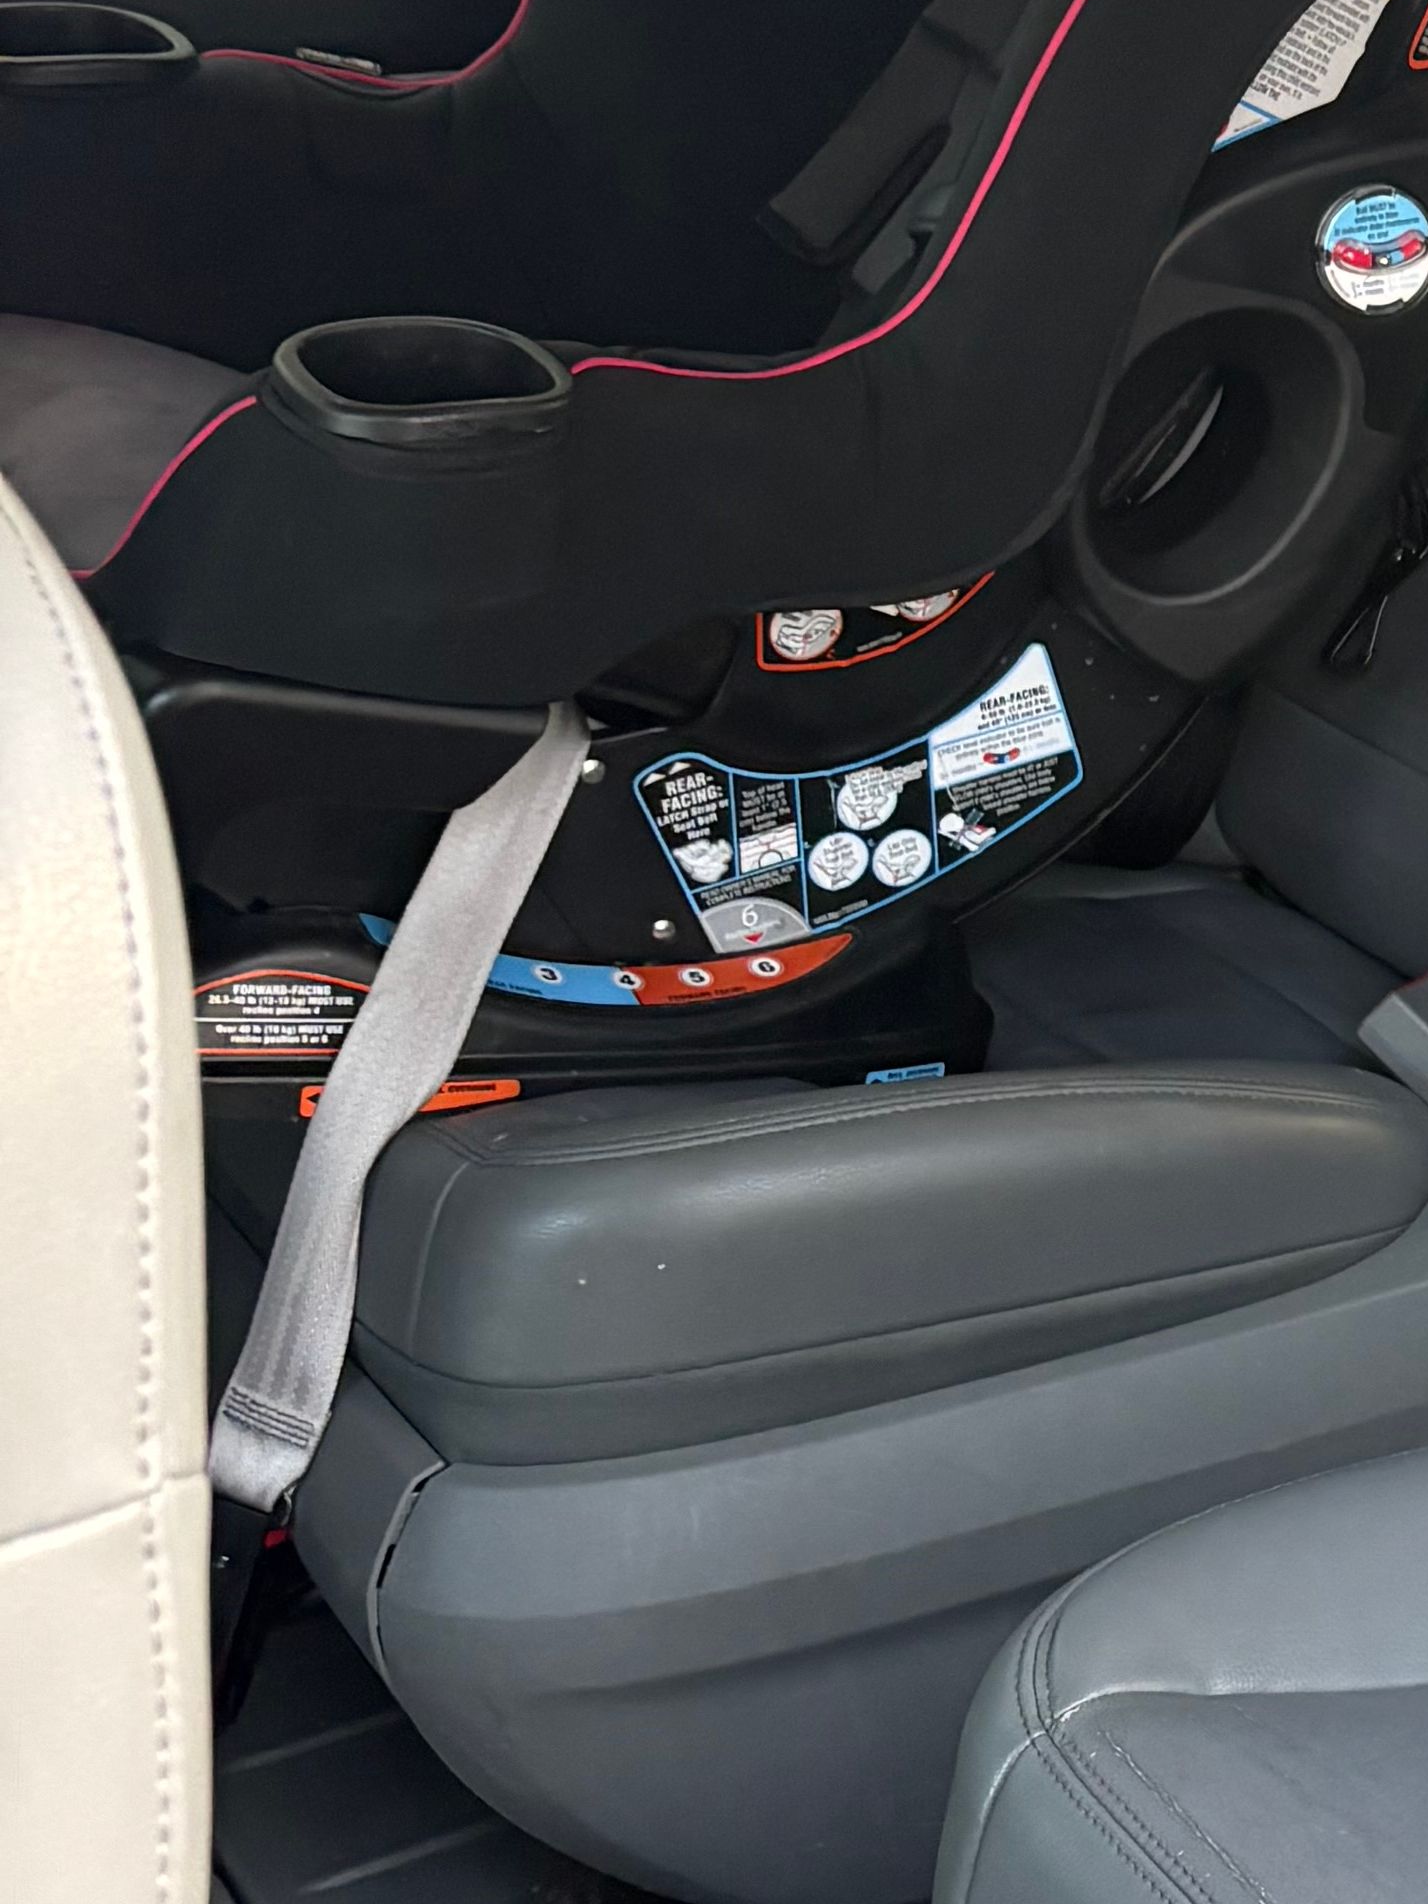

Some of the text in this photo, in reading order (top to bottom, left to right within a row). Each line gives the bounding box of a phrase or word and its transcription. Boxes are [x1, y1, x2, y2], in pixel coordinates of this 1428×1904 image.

[665, 772, 714, 797] REAR-
[661, 785, 724, 814] FACING:
[656, 809, 689, 827] LATCH
[673, 818, 696, 834] Seat
[742, 904, 758, 927] 6
[758, 960, 776, 973] 6
[689, 971, 706, 983] 5
[232, 984, 331, 995] FORWARD-FACING
